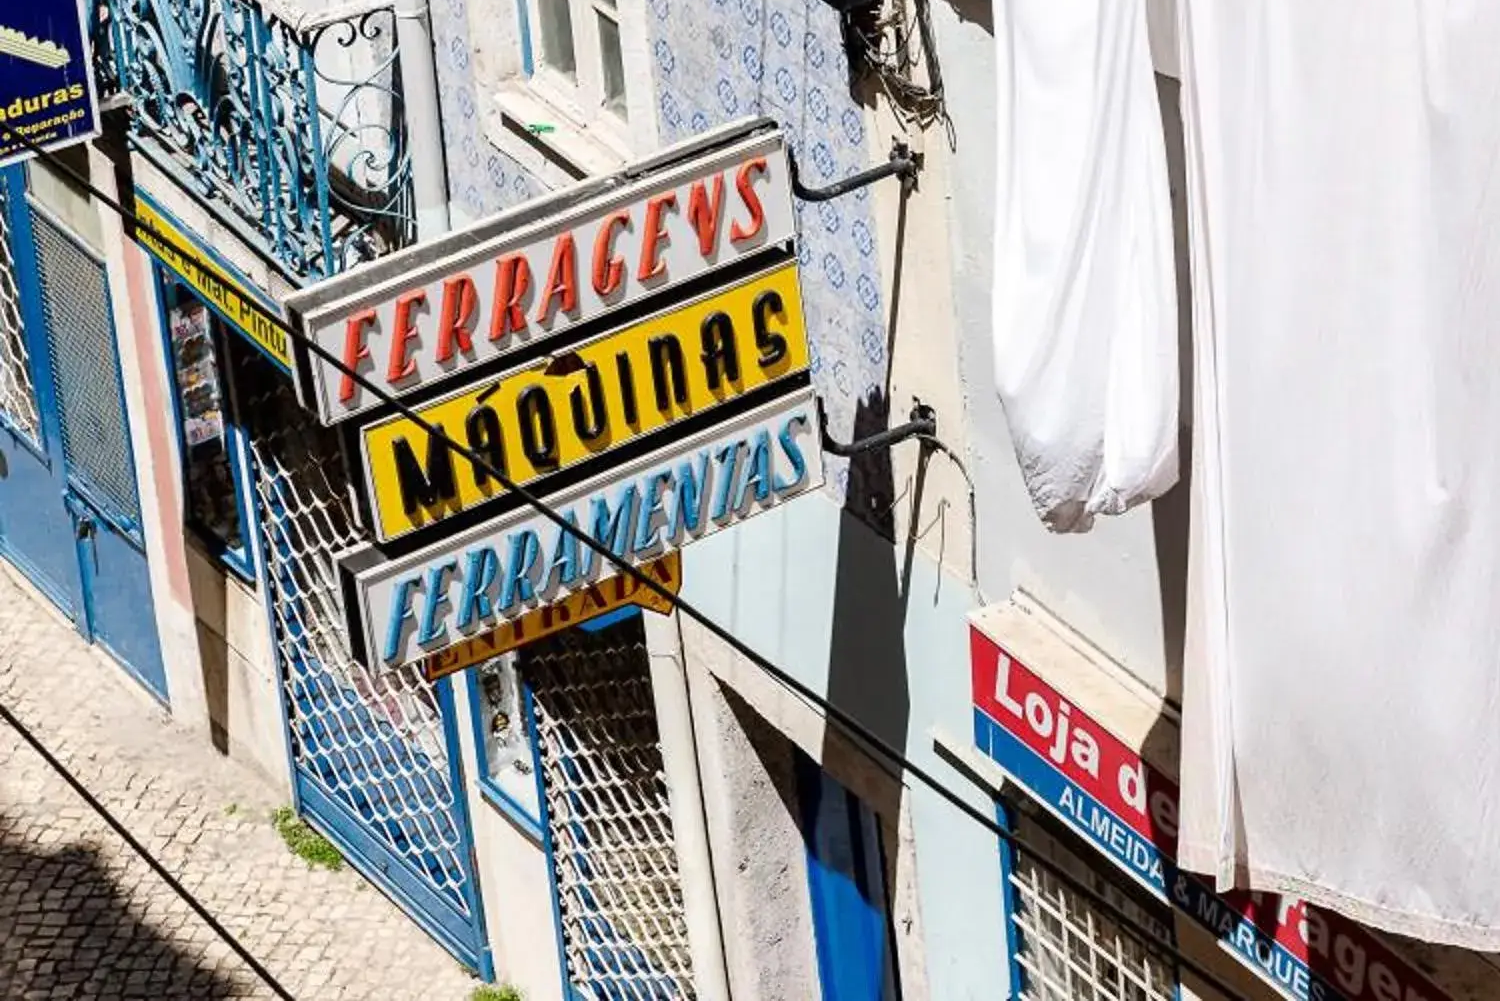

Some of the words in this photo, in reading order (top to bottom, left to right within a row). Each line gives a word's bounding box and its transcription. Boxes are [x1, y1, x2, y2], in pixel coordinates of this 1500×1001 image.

[383, 411, 809, 663] FERRAMENTAS
[995, 652, 1099, 780] Loja
[1118, 758, 1180, 839] de
[1059, 785, 1167, 888] ALMEIDA
[1173, 873, 1190, 907] &
[1198, 892, 1326, 1001] MARQUES
